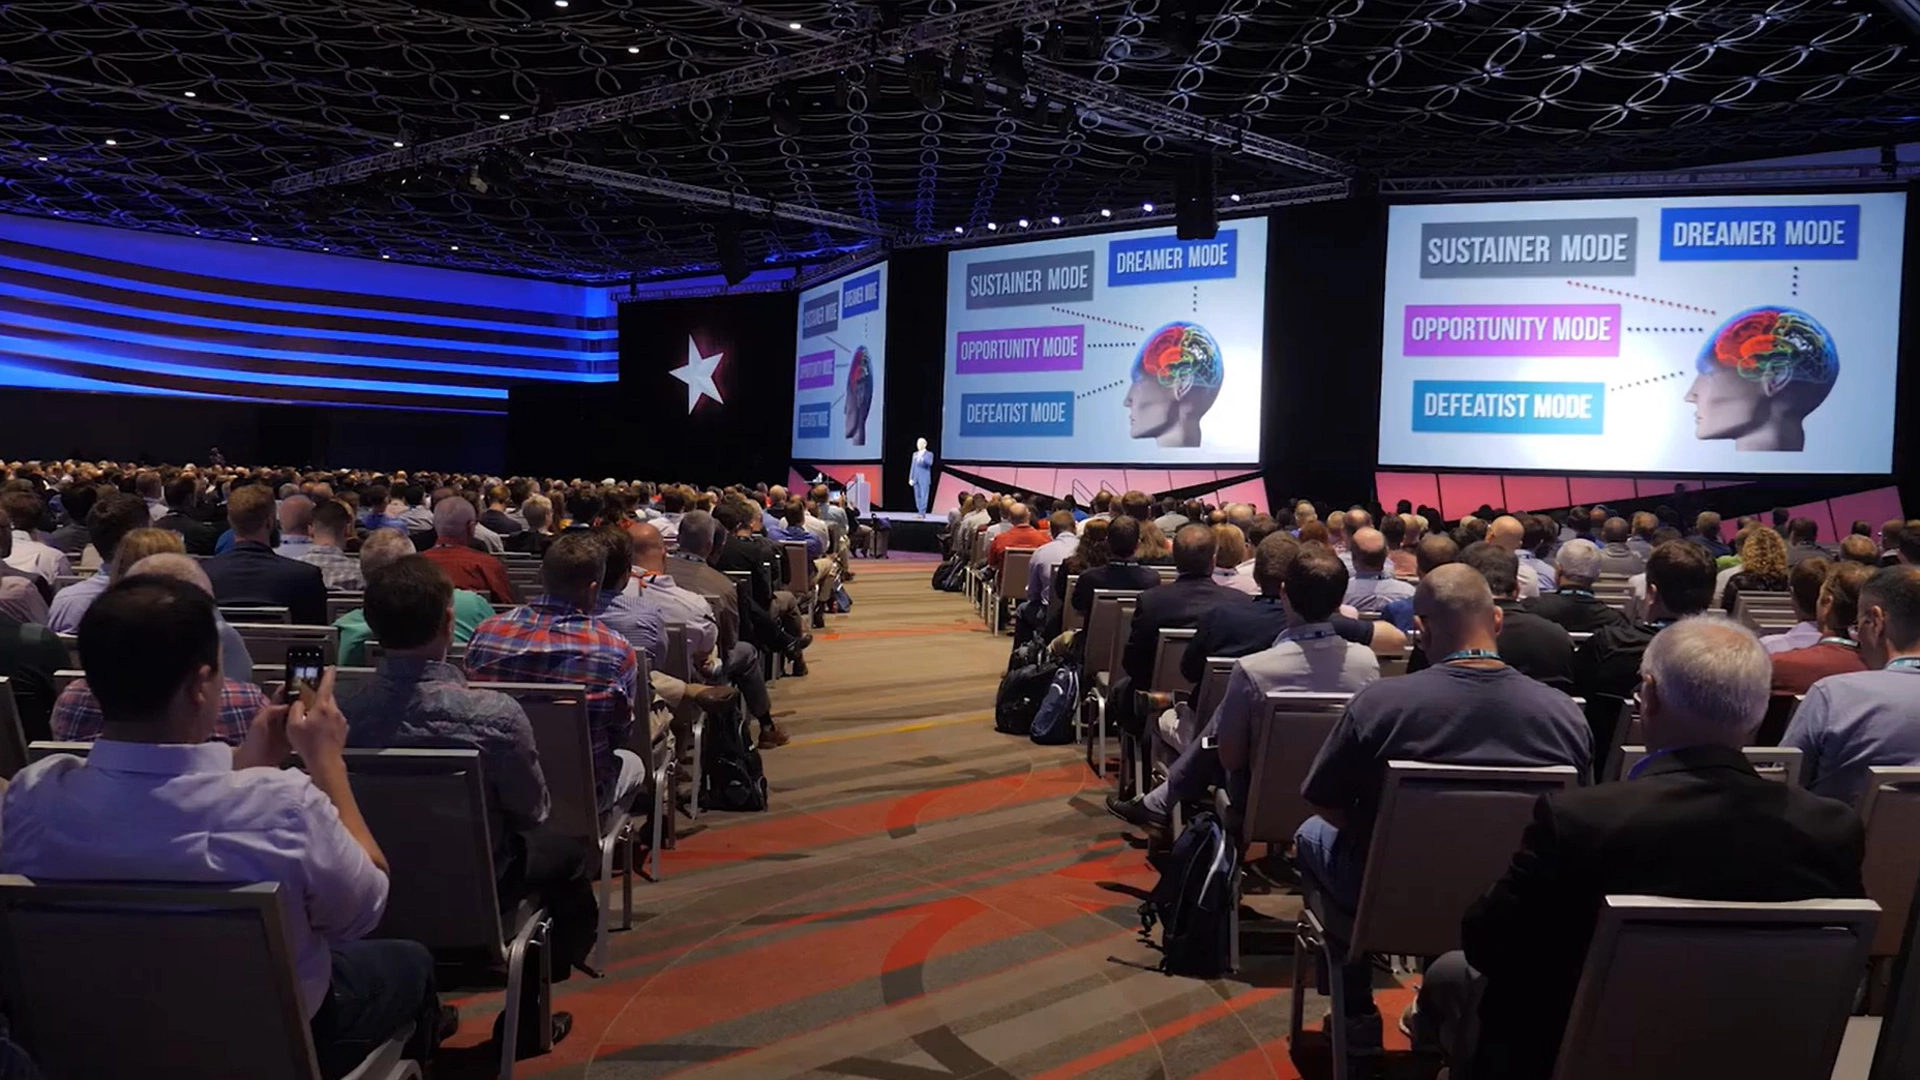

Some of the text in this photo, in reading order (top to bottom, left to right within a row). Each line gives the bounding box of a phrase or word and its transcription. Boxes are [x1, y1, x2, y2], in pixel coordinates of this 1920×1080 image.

[1673, 219, 1846, 247] DREAMER MODE
[1116, 243, 1229, 274] DREAMER MODE
[1428, 233, 1628, 265] SUSTAINER MODE
[970, 265, 1089, 297] SUSTAINER MODE
[1411, 316, 1611, 342] OPPORTUNITY MODE
[960, 336, 1078, 361] OPPORTUNITY MODE
[967, 402, 1066, 423] DEFEATIST MODE
[1424, 393, 1592, 419] DEFEATIST MODE
